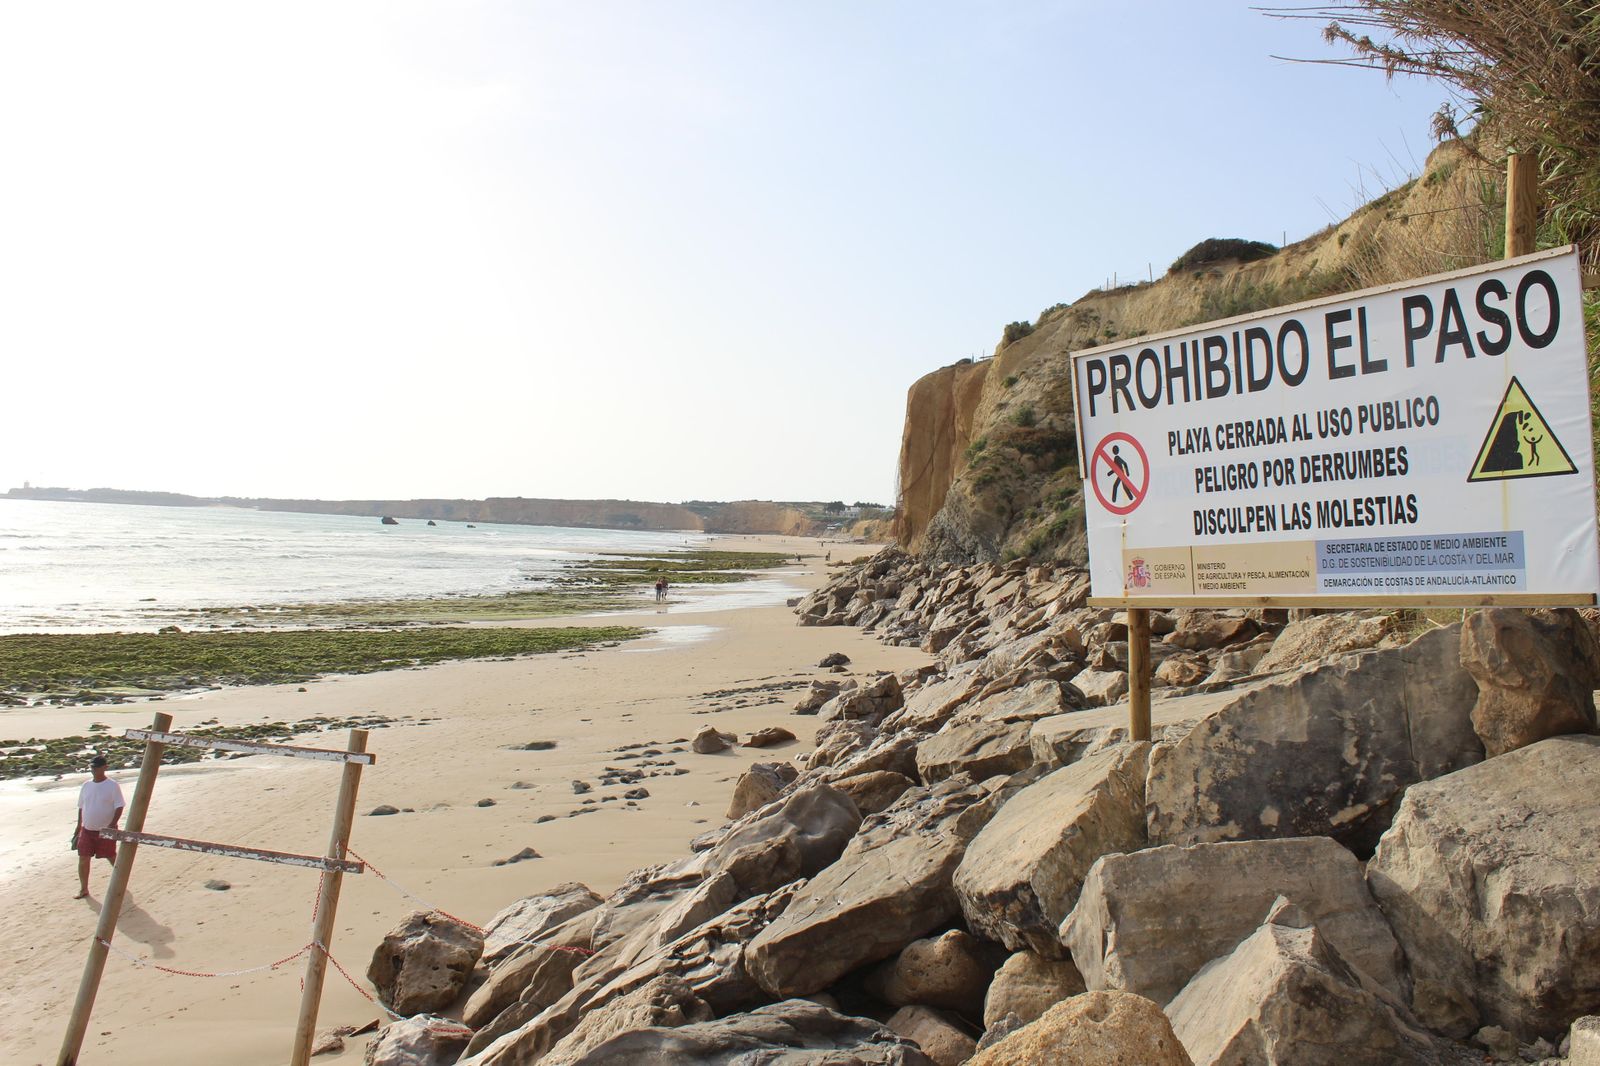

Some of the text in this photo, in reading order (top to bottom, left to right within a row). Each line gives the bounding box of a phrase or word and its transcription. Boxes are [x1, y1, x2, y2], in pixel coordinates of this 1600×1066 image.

[1086, 269, 1561, 417] PROHIBIDO EL PASO
[1168, 395, 1440, 456] PLAYA CERRADA AL USO PUBLICO
[1195, 461, 1258, 493] PELIGRO
[1263, 456, 1296, 486] POR
[1300, 446, 1409, 484] DERRUMBES
[1193, 494, 1418, 535] DISCULPEN LAS MOLESTIAS
[1374, 542, 1385, 552] DE
[1387, 540, 1419, 552] ESTADO
[1420, 540, 1432, 550] DE
[1434, 538, 1460, 550] MEDIO
[1462, 536, 1507, 549] AMBIENTE
[1196, 562, 1226, 570] MINISTERIO
[1339, 558, 1349, 568] DE
[1350, 556, 1413, 568] SOSTENIBILIDAD
[1415, 555, 1426, 566] DE
[1427, 555, 1438, 566] LA
[1438, 554, 1467, 565] COSTA
[1468, 553, 1474, 564] Y
[1476, 553, 1493, 564] DEL
[1494, 552, 1515, 564] MAR
[1154, 563, 1186, 572] GOBIERNO
[1164, 570, 1186, 579] ESPAÑA
[1205, 571, 1242, 580] AGRICULTURA
[1242, 571, 1248, 579] Y
[1198, 582, 1247, 590] Y MEDIO AMBIENTE
[1323, 576, 1373, 587] DEMARCACIÓN
[1374, 578, 1384, 587] DE
[1385, 577, 1414, 587] COSTAS
[1415, 576, 1426, 586] DE
